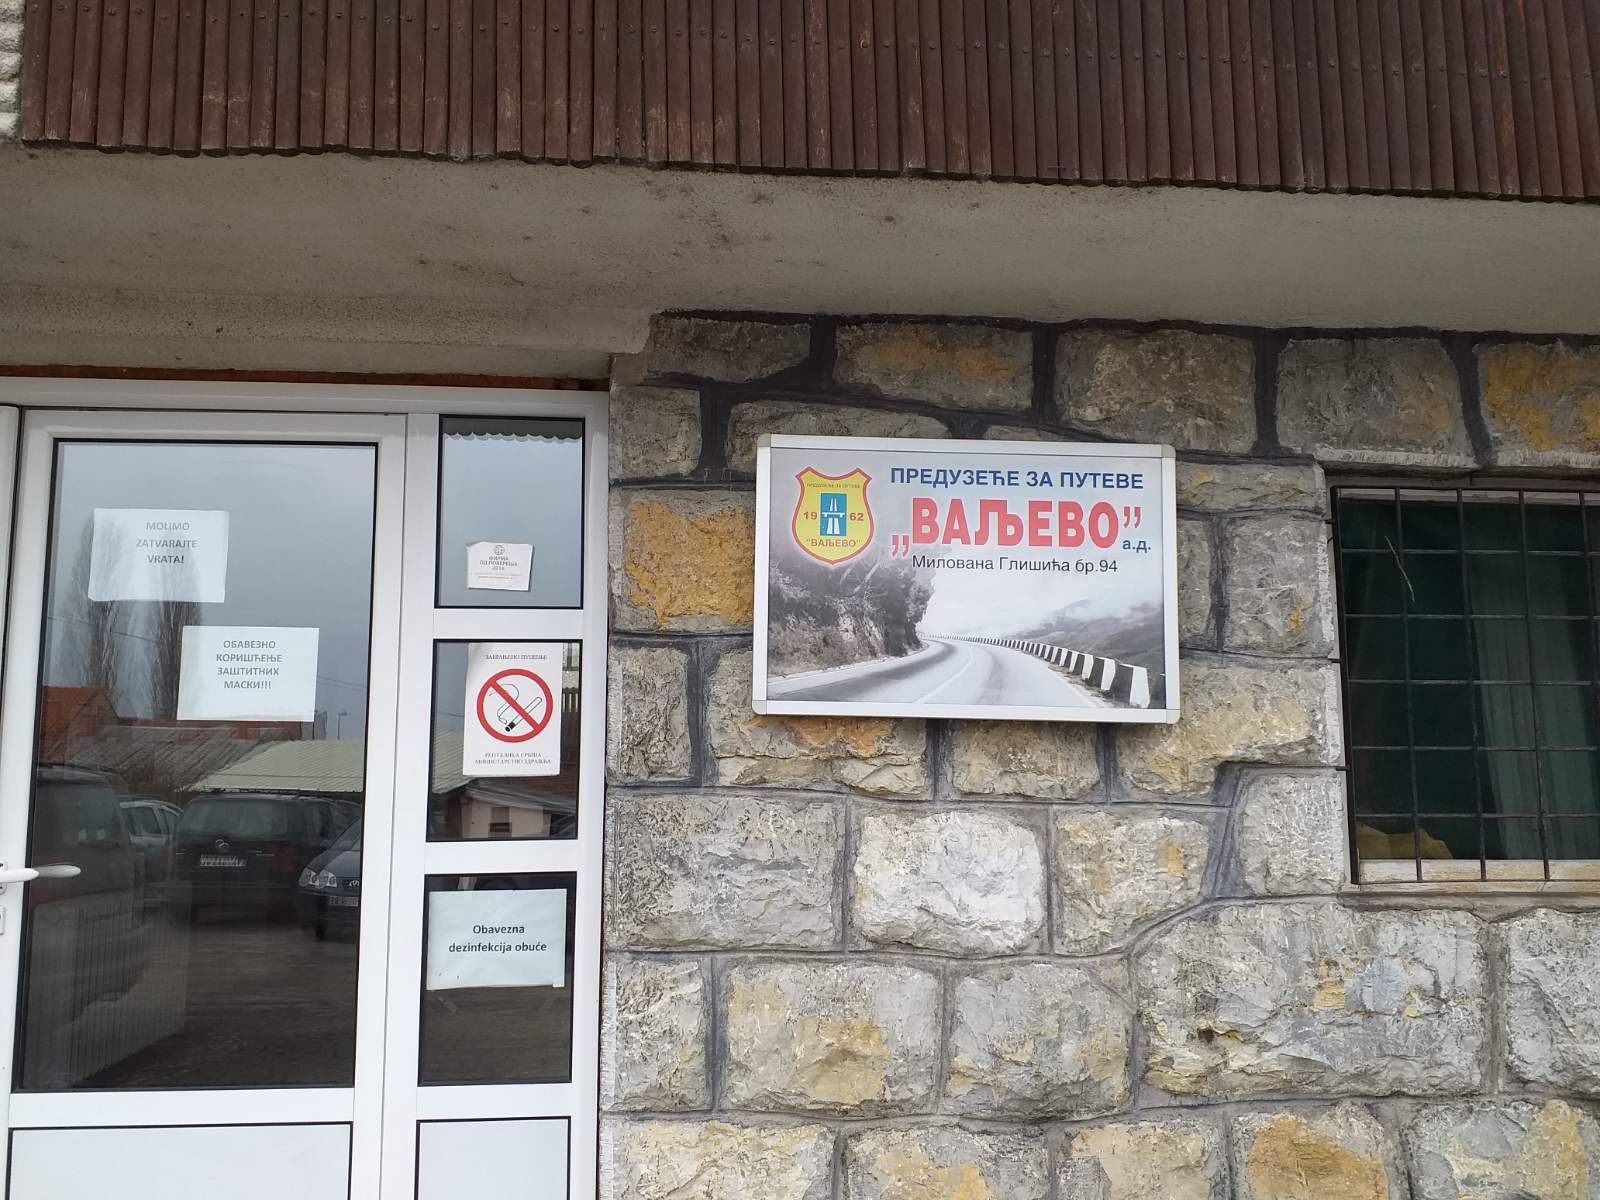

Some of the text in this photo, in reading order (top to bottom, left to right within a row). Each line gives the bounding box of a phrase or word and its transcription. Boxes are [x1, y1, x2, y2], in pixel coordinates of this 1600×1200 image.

[891, 467, 1144, 489] ПРЕДУЗЕЋЕ ЗА ПУТЕВЕ
[804, 511, 864, 522] 19 62
[146, 521, 190, 531] MOLIMO
[136, 538, 198, 548] ZATVARAJTE
[1122, 539, 1151, 553] а.д.
[147, 554, 184, 564] VRATA!
[912, 555, 1118, 575] Милована Глишића бр.94
[223, 640, 276, 649] ОБАВЕЗНО
[216, 653, 282, 663] КОРИШЋЕЊЕ
[217, 667, 279, 676] ЗАШТИТНИХ
[224, 680, 271, 689] МАСКИ!!!
[472, 925, 525, 934] Obavezna
[449, 941, 547, 954] dezinfekcija obuće
